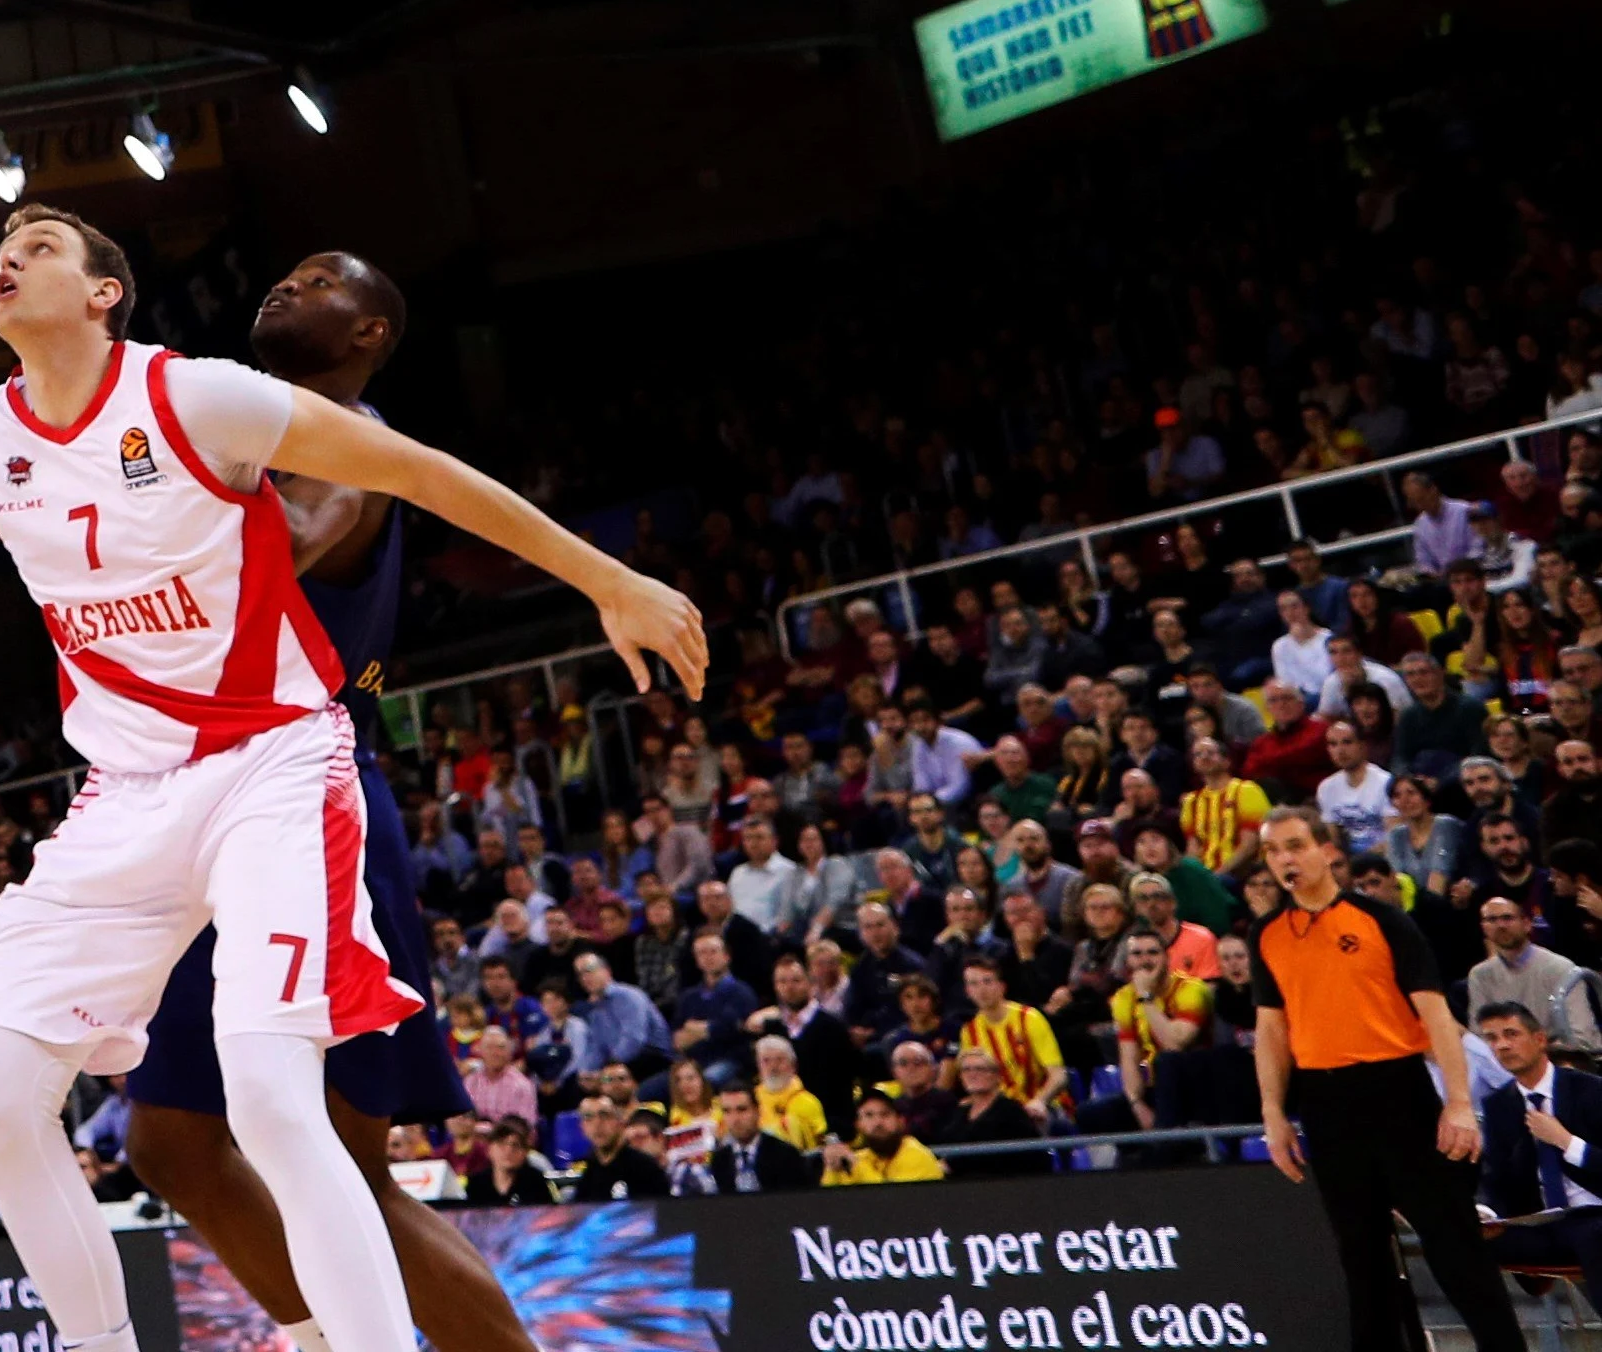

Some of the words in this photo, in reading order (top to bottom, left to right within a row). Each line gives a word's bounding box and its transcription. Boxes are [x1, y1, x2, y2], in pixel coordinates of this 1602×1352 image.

[957, 45, 997, 81] QUE
[1005, 27, 1052, 61] HAN
[1057, 11, 1093, 43] FET
[0, 499, 44, 512] KELME
[67, 502, 103, 571] 7
[268, 933, 309, 1003] 7
[791, 1224, 957, 1282] Nascut
[963, 1228, 1044, 1287] per
[1055, 1220, 1180, 1272] estar
[808, 1293, 988, 1351] còmode
[998, 1303, 1064, 1348] en
[1071, 1289, 1120, 1348] el
[1130, 1301, 1268, 1346] caos.
